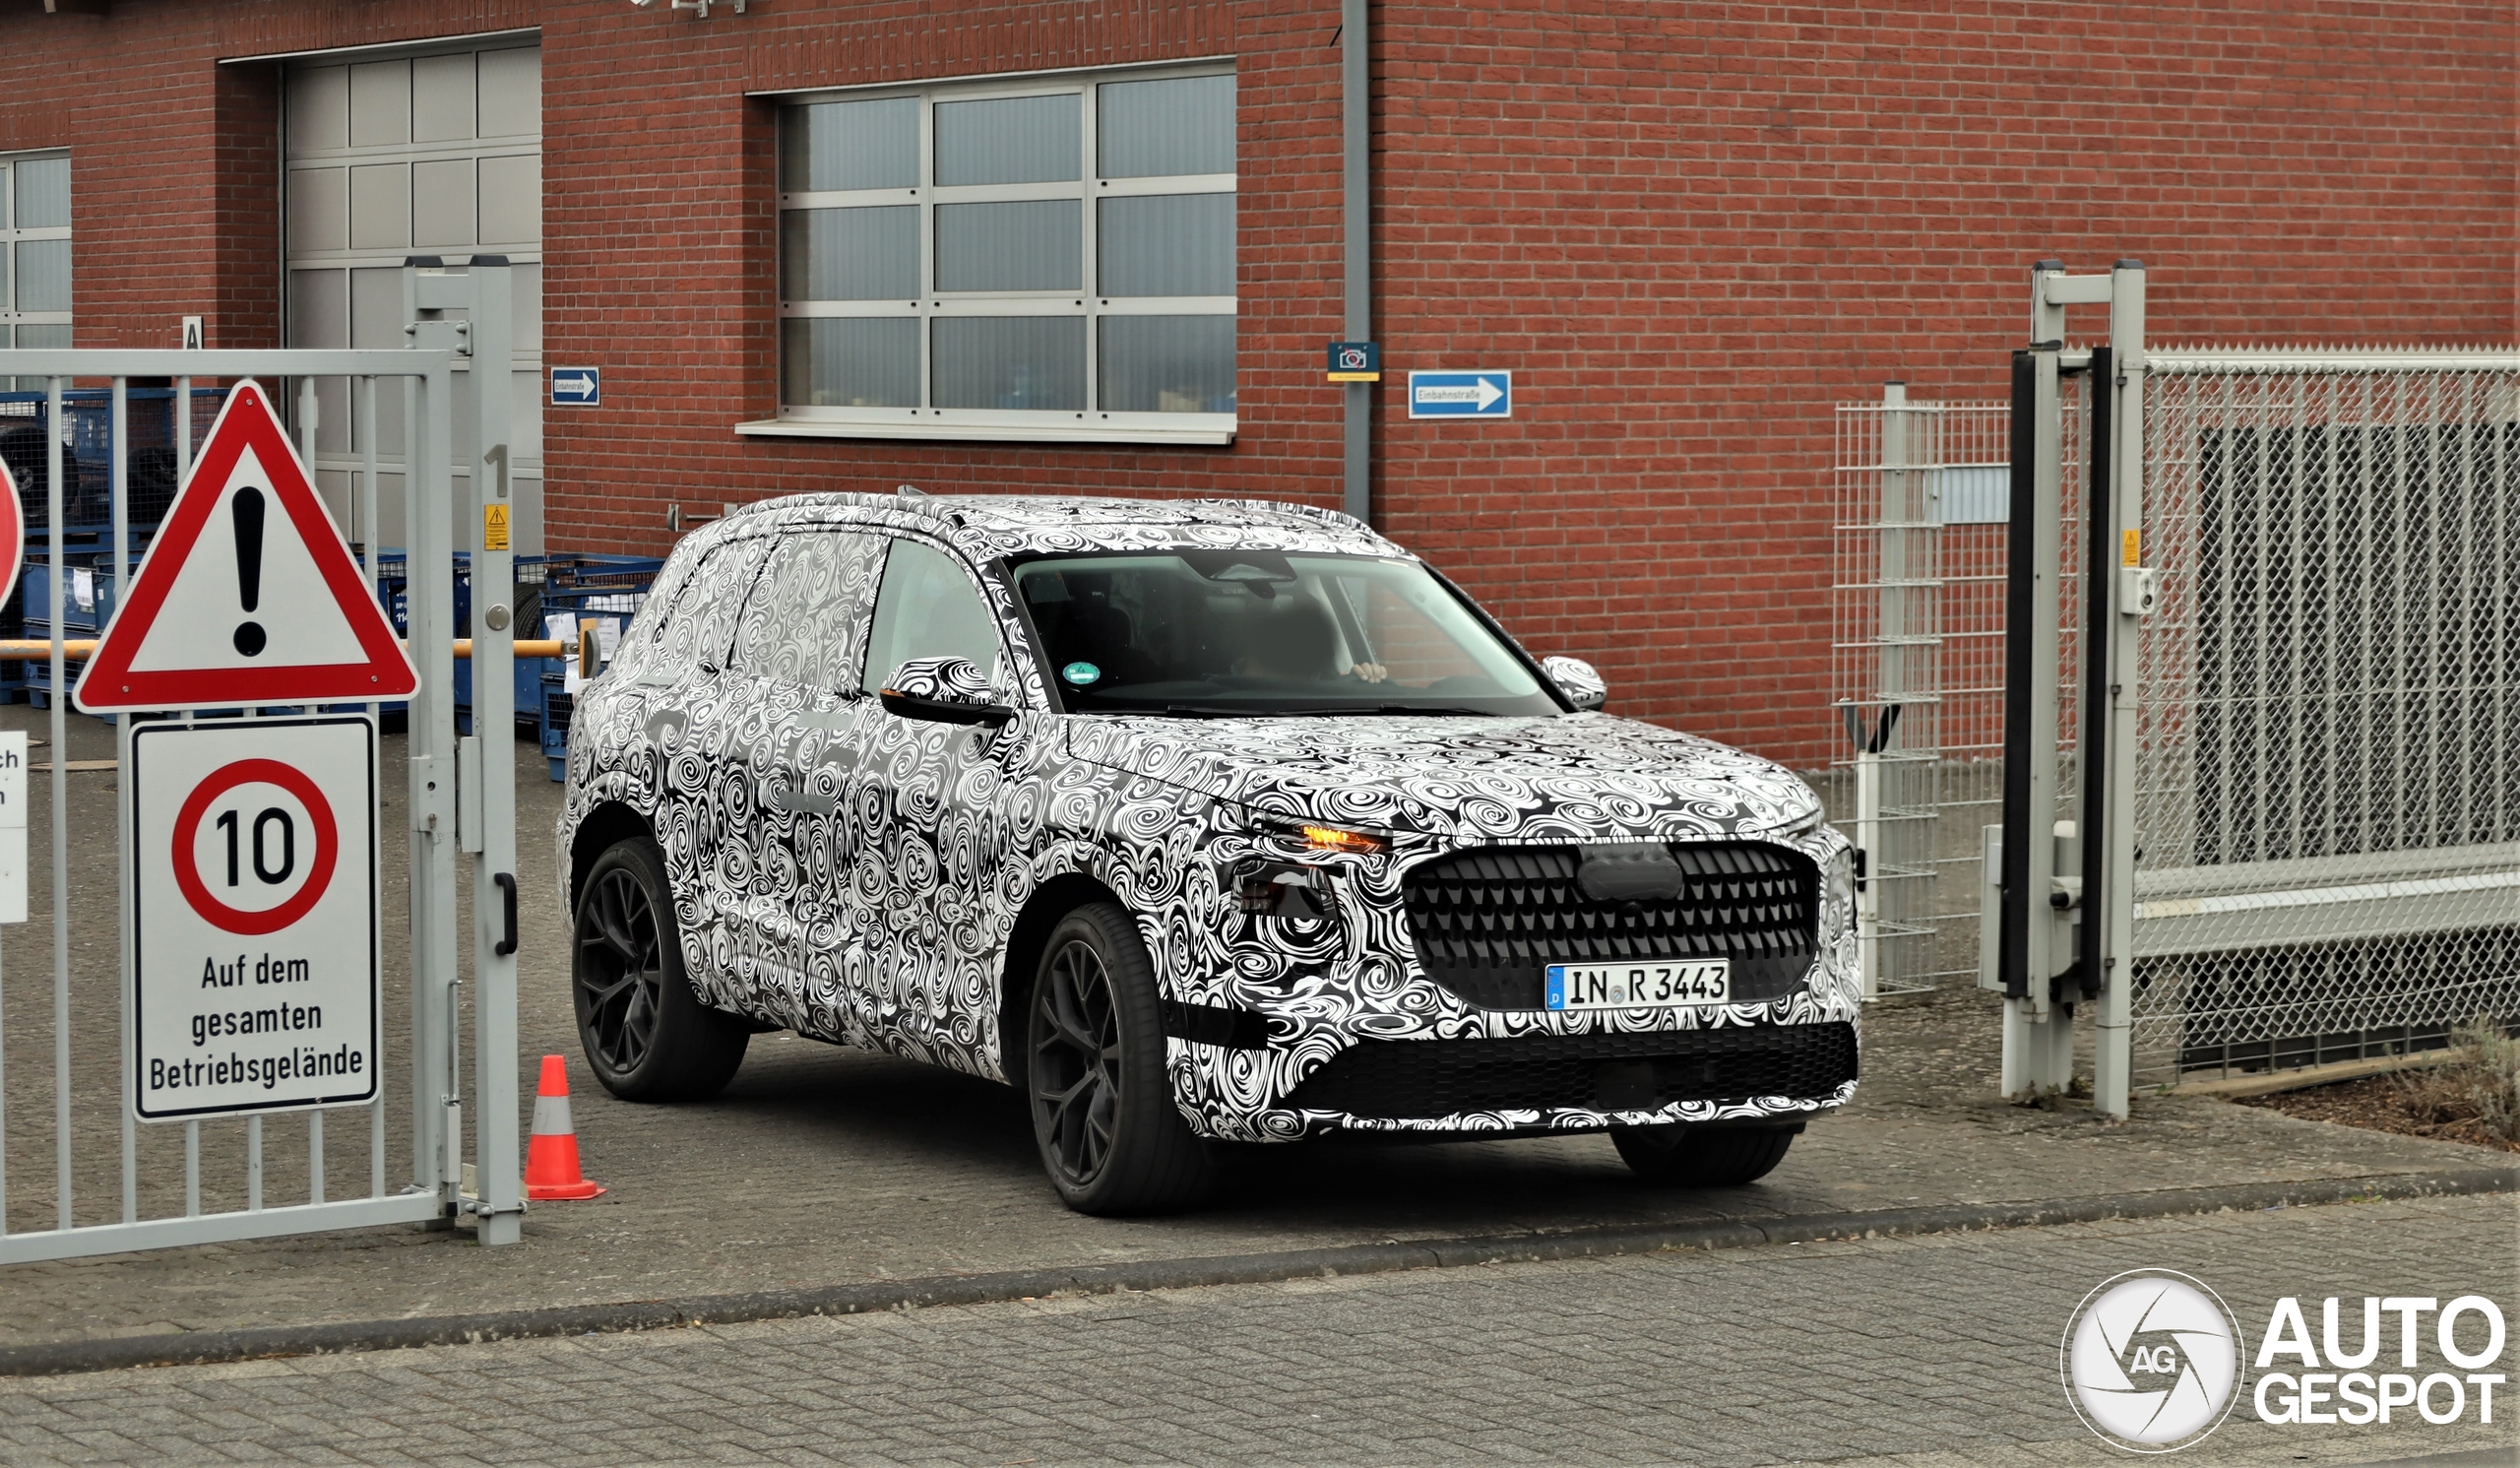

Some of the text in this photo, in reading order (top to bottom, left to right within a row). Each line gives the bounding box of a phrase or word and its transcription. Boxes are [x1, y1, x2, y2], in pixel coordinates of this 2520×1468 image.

[187, 324, 198, 350] A
[1418, 390, 1480, 400] Einbahnstraße
[484, 444, 507, 497] 1
[216, 806, 295, 887] 10
[201, 952, 309, 989] Auf dem
[1570, 966, 1725, 1004] IN R 3443
[1551, 992, 1559, 1003] D
[192, 1001, 322, 1047] gesamten
[151, 1043, 363, 1090] Betriebsgelände
